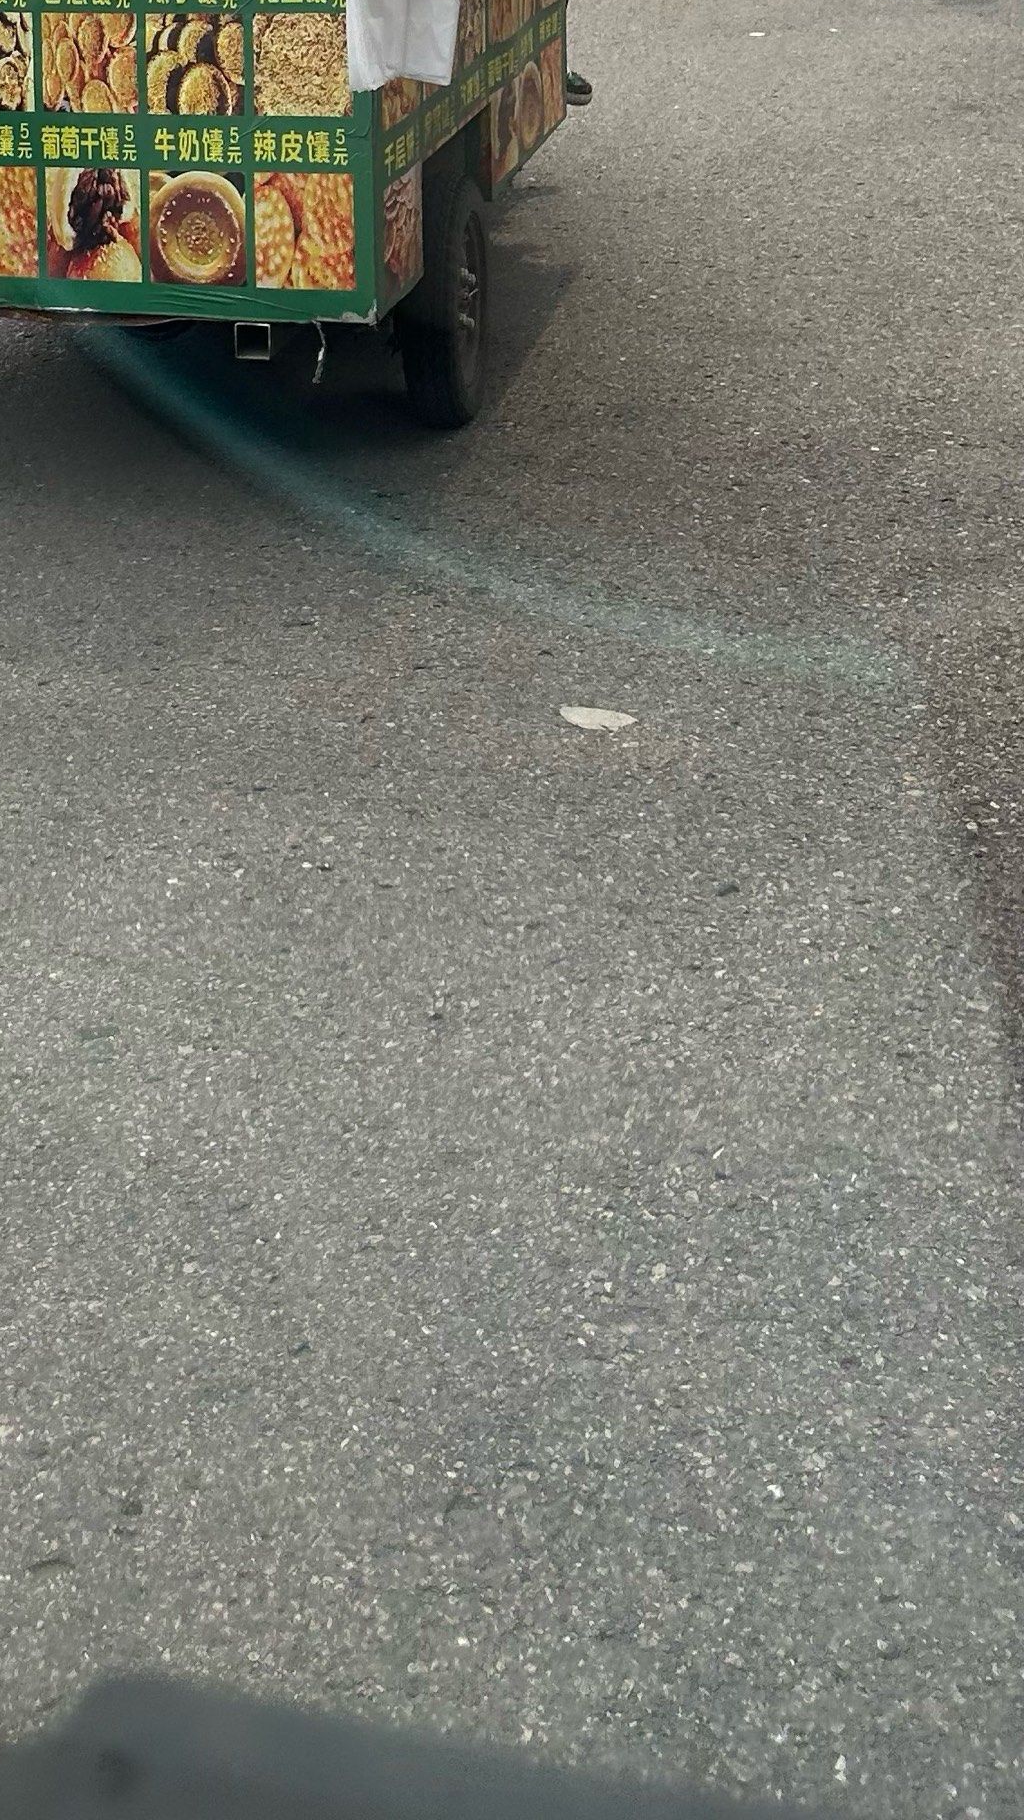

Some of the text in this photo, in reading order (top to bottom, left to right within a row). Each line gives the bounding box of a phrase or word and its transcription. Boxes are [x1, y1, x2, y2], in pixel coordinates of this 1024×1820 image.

[41, 126, 119, 161] 葡萄干馕
[154, 128, 224, 163] 牛奶馕
[253, 129, 331, 164] 辣皮馕
